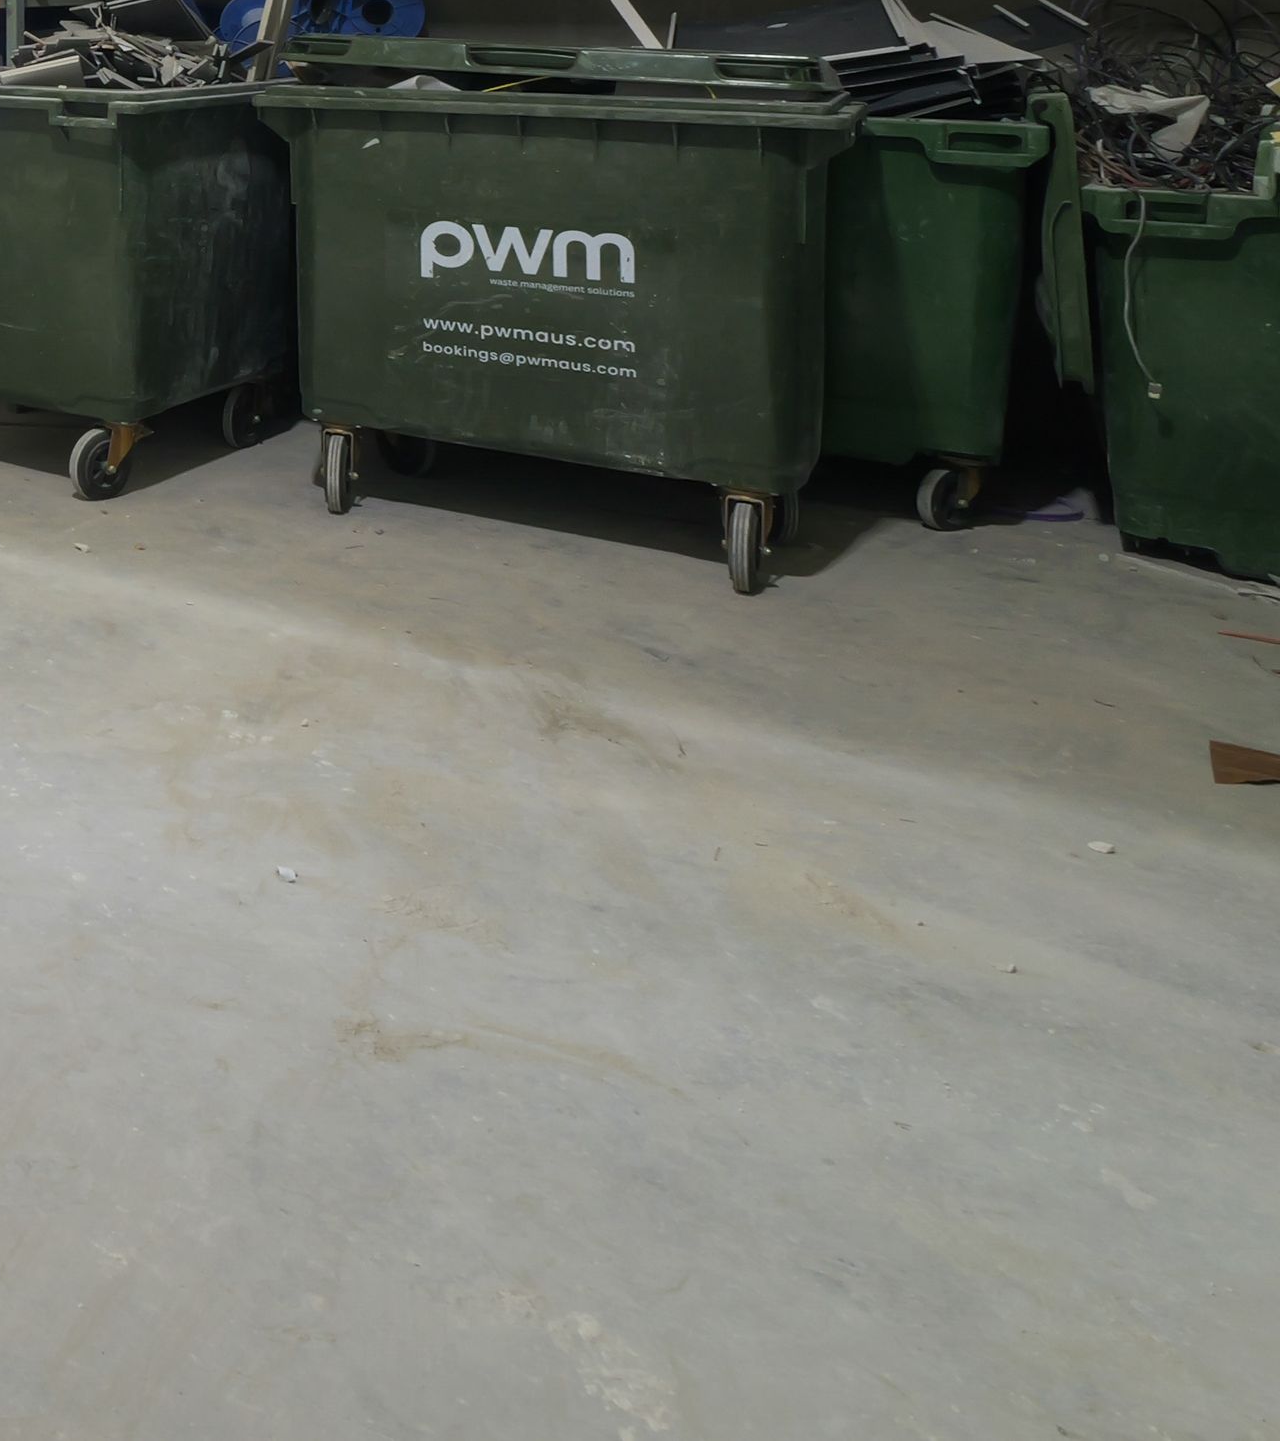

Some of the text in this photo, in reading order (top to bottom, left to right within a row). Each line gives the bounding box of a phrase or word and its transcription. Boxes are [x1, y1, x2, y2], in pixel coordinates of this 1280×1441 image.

[420, 220, 636, 284] pwm
[489, 277, 636, 298] waste management solutions
[423, 317, 636, 353] www.pwmaus.com
[422, 341, 637, 379] bookings@pwmaus.com
